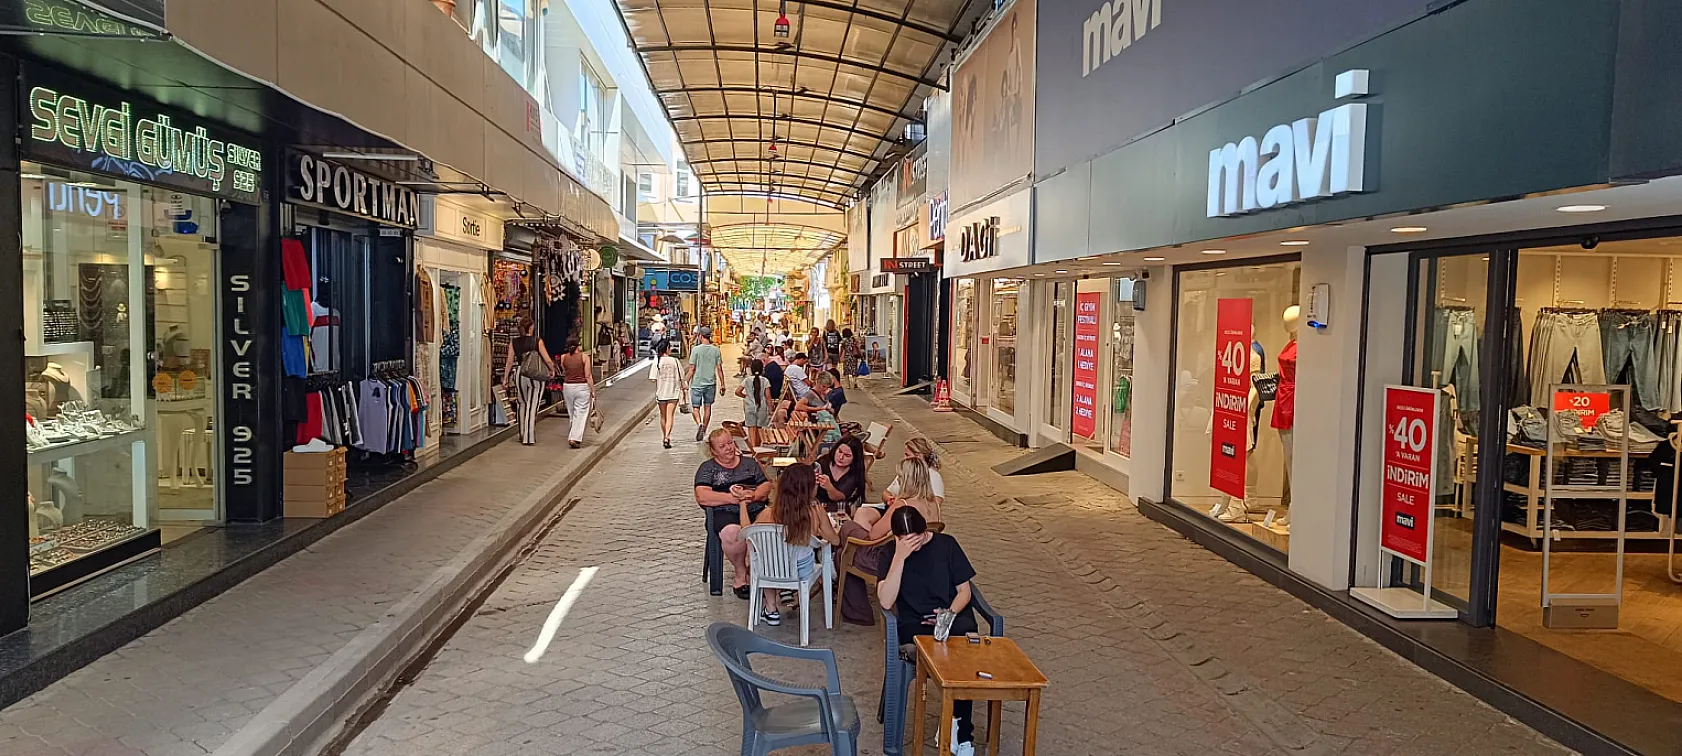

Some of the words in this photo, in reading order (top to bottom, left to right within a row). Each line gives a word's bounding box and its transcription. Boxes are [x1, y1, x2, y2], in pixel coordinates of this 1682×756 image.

[29, 86, 131, 160] SEVGİ
[136, 113, 224, 192] GÜMÜŞ
[1207, 69, 1369, 218] mavi
[233, 169, 255, 193] 925
[300, 154, 420, 228] SPORTMAN
[462, 216, 481, 237] Sortie
[899, 261, 926, 269] STREET
[230, 275, 252, 399] SILVER
[1223, 418, 1237, 432] SALE
[232, 425, 252, 485] 925
[1401, 451, 1421, 463] VARAN
[1397, 492, 1415, 506] SALE
[1396, 516, 1415, 528] mavi
